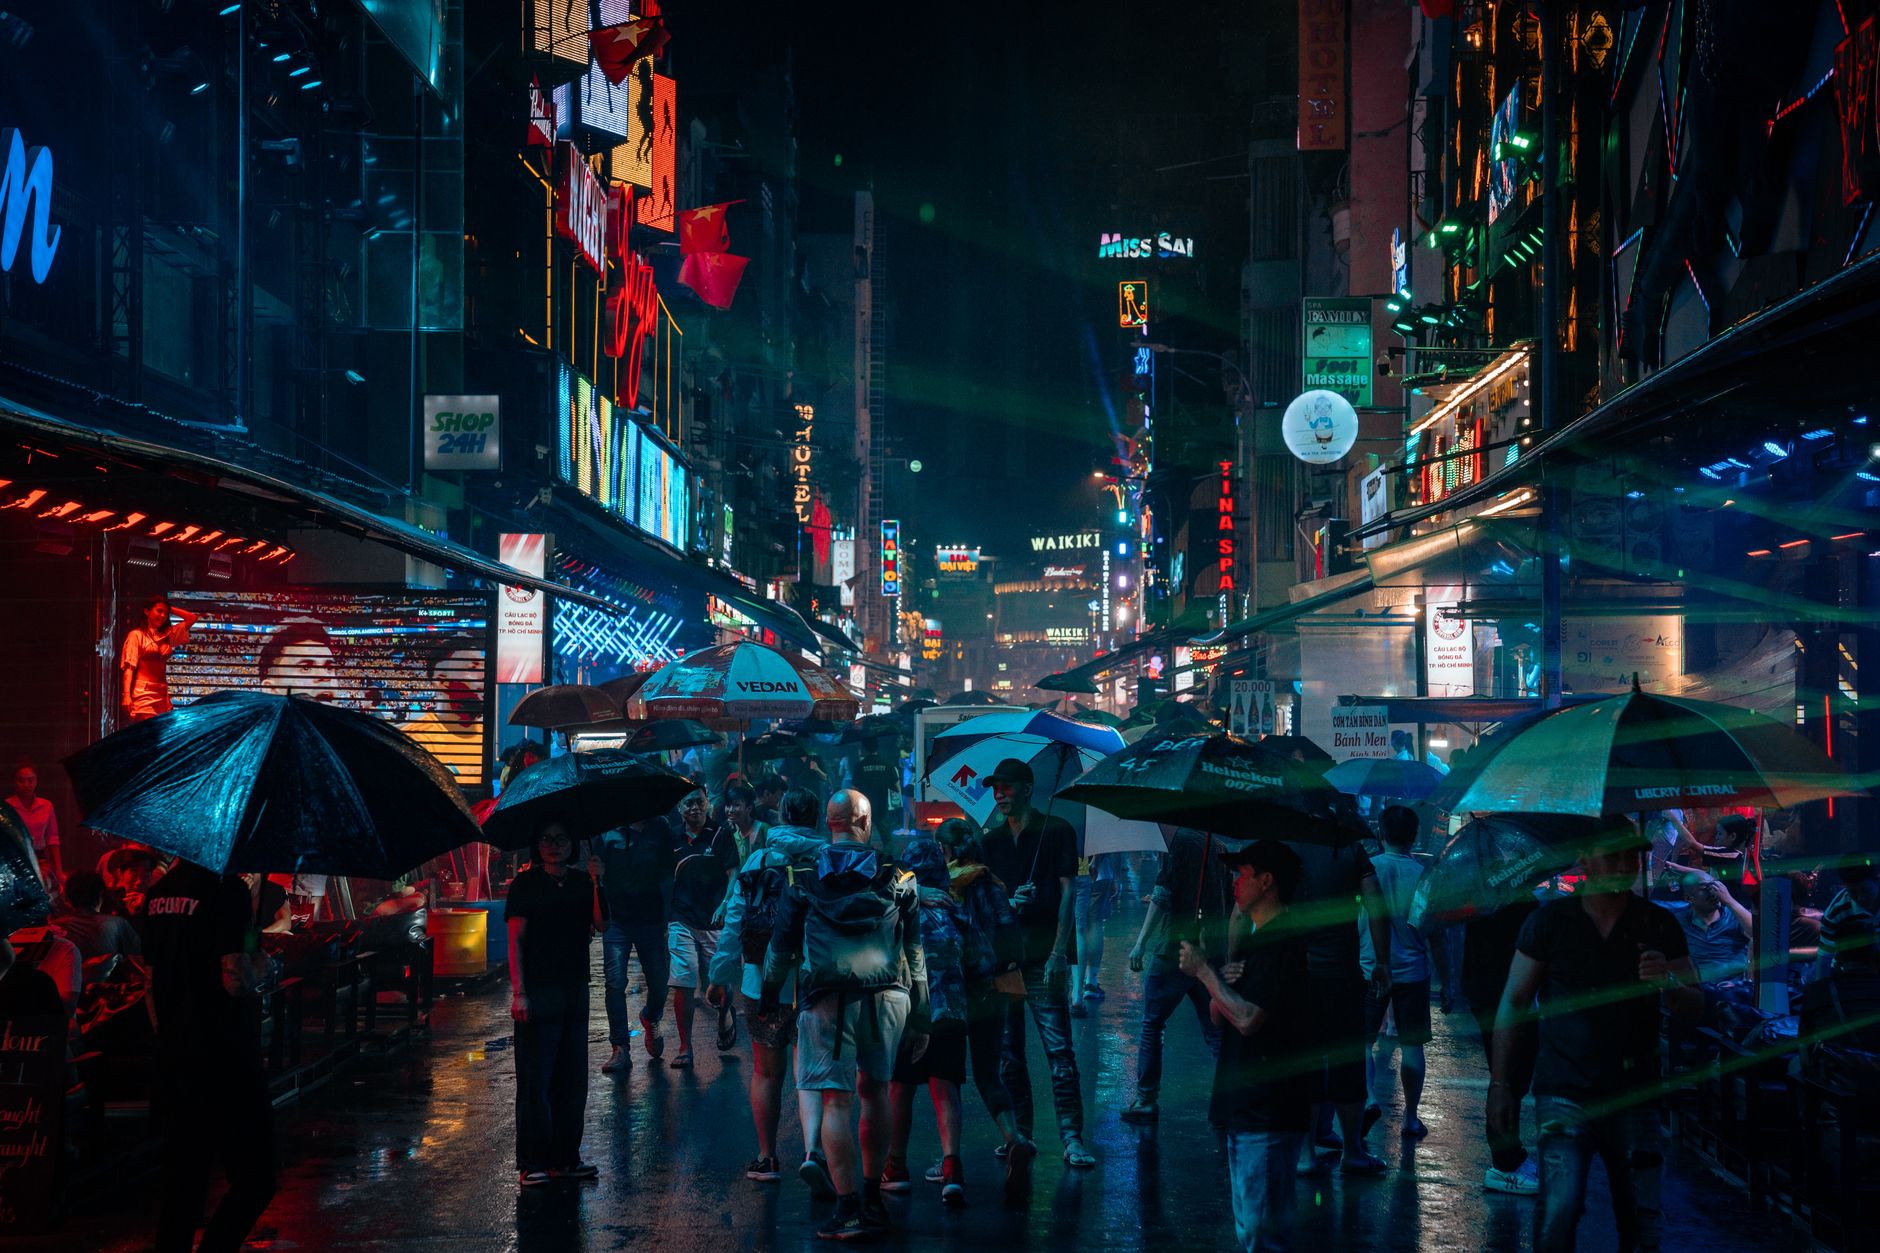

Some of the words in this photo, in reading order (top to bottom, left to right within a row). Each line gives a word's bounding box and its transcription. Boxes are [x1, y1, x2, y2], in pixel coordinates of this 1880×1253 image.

[1307, 310, 1369, 323] FAMILY
[1306, 373, 1369, 388] Massage
[430, 411, 494, 433] SHOP
[437, 433, 487, 454] 24H
[1218, 461, 1234, 530] TINA
[1031, 533, 1100, 551] WAIKIKI
[883, 528, 897, 595] TATTOO
[1218, 539, 1234, 590] SPA
[1046, 627, 1089, 637] WAIKIKI
[736, 681, 799, 693] VEDAN
[1234, 681, 1271, 692] 20.000
[1334, 731, 1361, 747] Bánh
[1365, 731, 1387, 747] Men
[580, 759, 638, 770] Heineken
[602, 766, 627, 775] 007
[1201, 761, 1283, 786] Heineken
[1225, 778, 1261, 792] 007
[1634, 786, 1681, 800] LIBERTY
[1486, 849, 1545, 888] Heineken
[1509, 866, 1535, 888] 007
